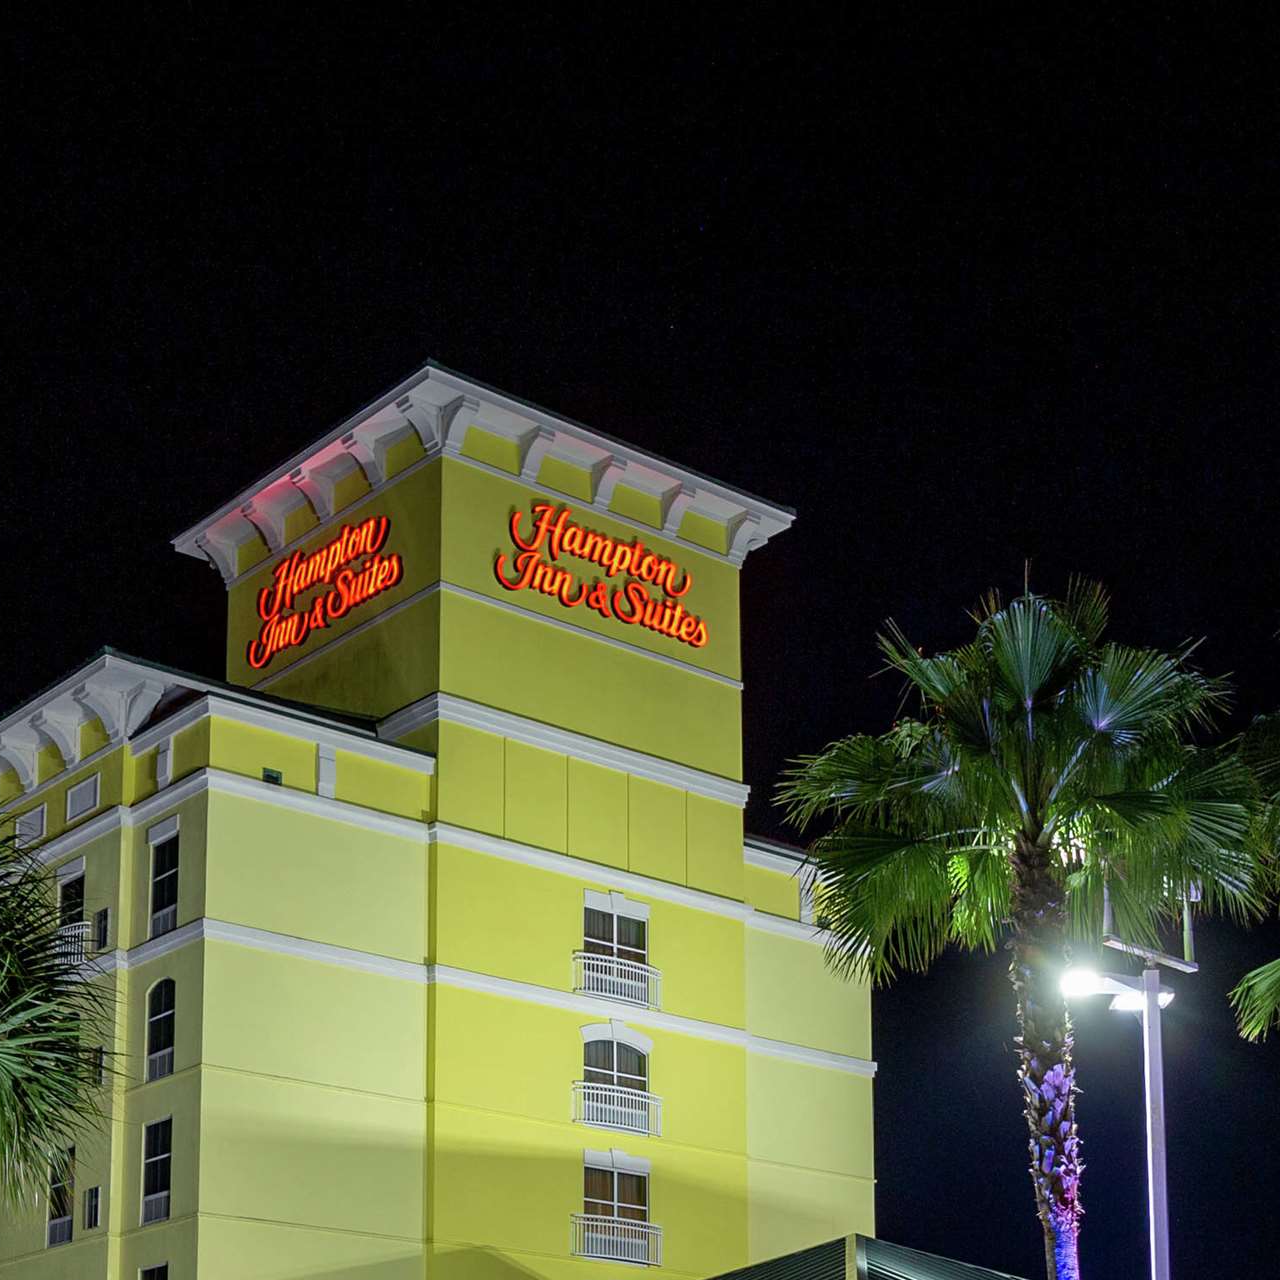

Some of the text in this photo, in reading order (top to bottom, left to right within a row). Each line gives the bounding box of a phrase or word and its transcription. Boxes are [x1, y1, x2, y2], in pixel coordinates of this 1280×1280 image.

[258, 515, 388, 621] Hampton
[494, 550, 710, 648] Inn & Suites
[509, 503, 693, 598] Hampton
[248, 553, 400, 669] Inn & Suites
